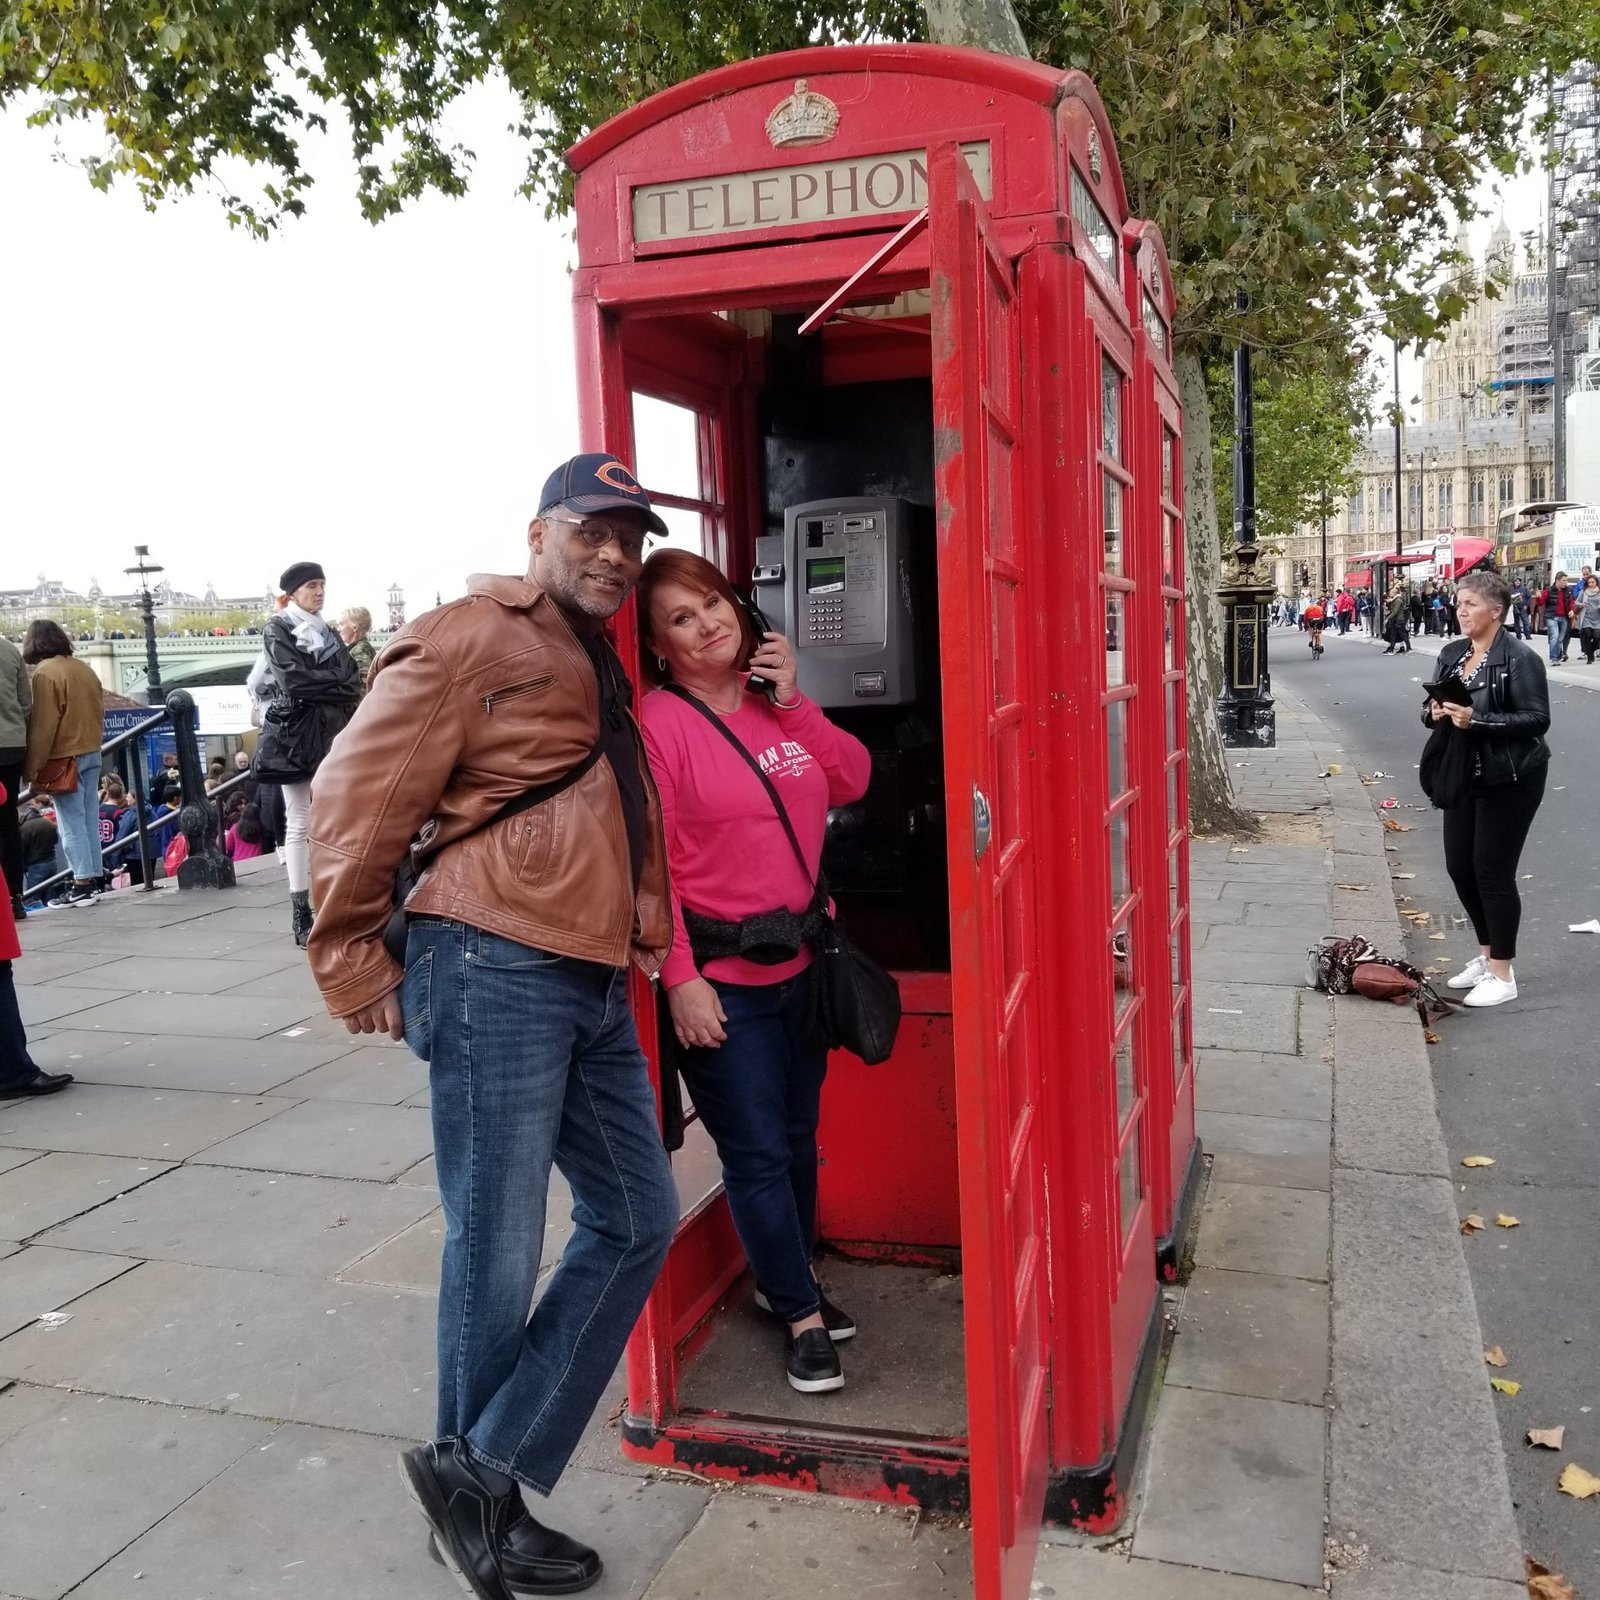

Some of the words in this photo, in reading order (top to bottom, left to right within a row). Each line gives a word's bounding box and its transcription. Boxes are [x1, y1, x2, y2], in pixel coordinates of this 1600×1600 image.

[647, 151, 979, 235] TELEPHON
[218, 702, 243, 710] Tickets
[758, 746, 780, 770] AN
[780, 741, 808, 757] DIE
[764, 754, 813, 775] ALIFORN
